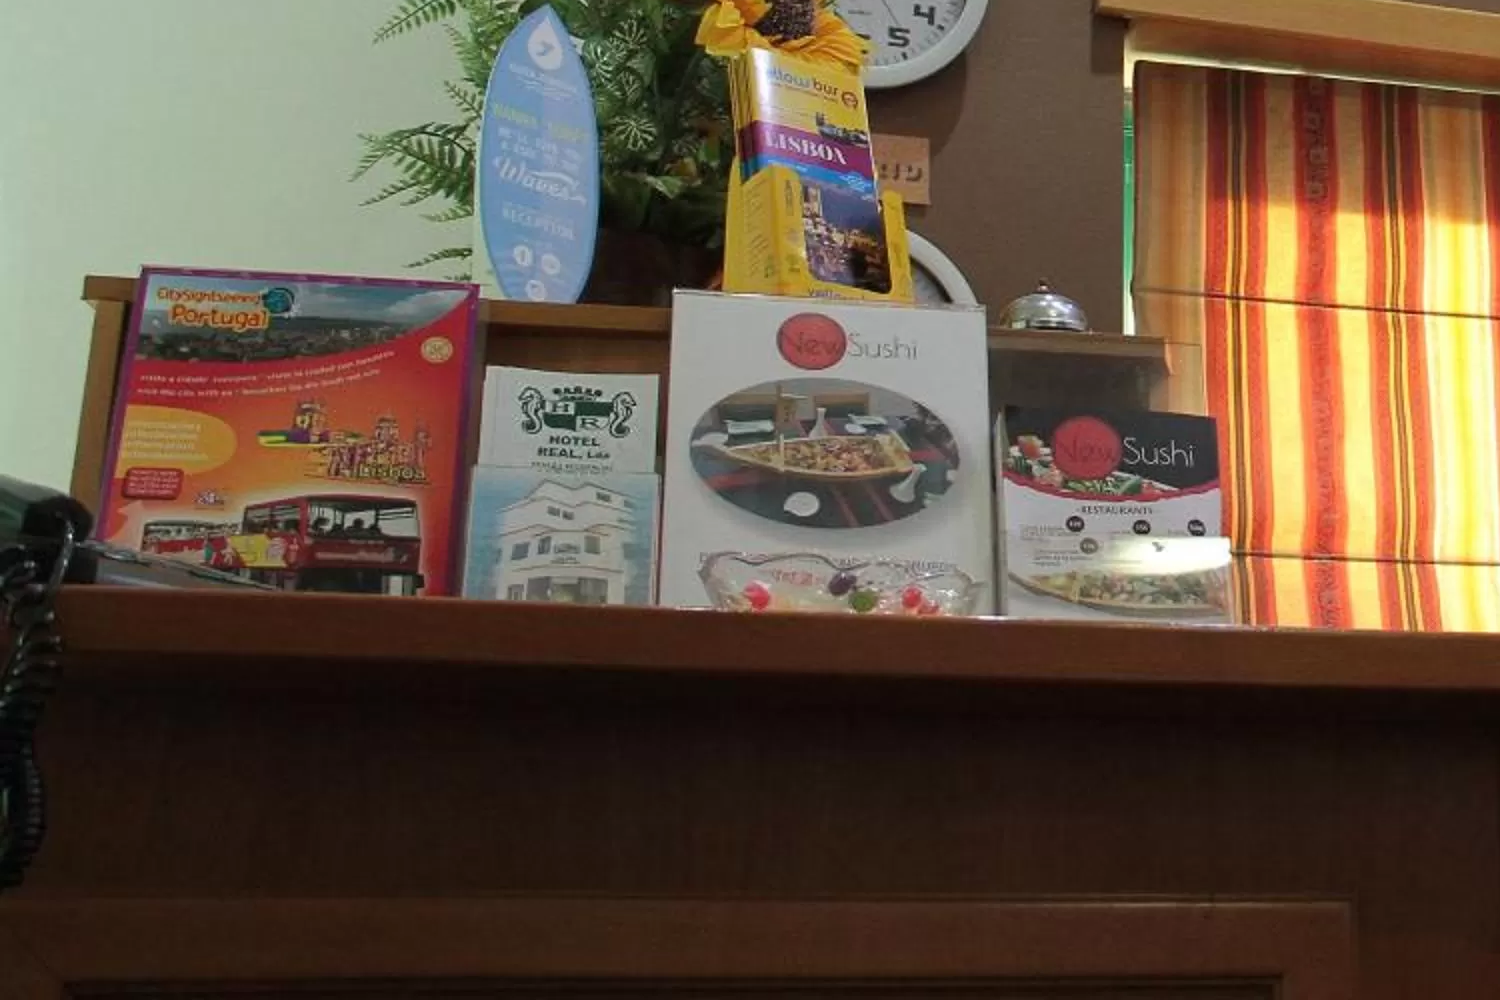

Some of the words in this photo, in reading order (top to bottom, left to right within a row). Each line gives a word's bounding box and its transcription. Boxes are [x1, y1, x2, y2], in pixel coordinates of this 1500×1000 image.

[914, 4, 936, 26] 4
[888, 26, 910, 47] 5
[764, 129, 848, 165] LISBOA
[170, 303, 268, 331] Portugal
[848, 332, 918, 360] Sushi
[549, 436, 600, 447] HOTEL
[1123, 436, 1195, 467] Sushi
